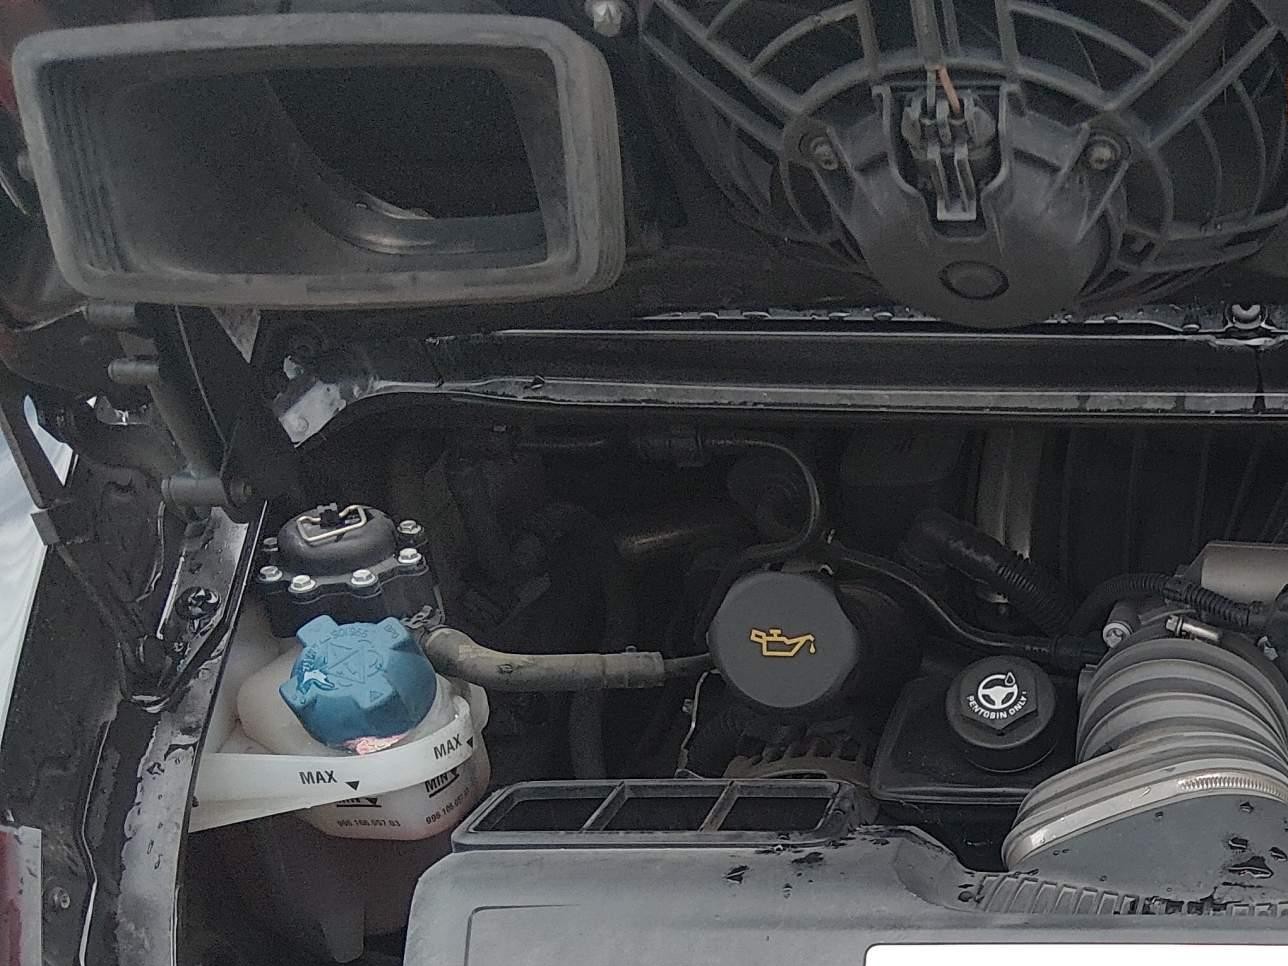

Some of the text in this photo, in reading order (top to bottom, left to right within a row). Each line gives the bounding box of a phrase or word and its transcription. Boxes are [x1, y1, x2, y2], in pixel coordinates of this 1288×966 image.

[966, 695, 1008, 719] PENTOSIN
[434, 733, 463, 760] MAX
[299, 769, 338, 785] MAX
[424, 772, 449, 793] MIN
